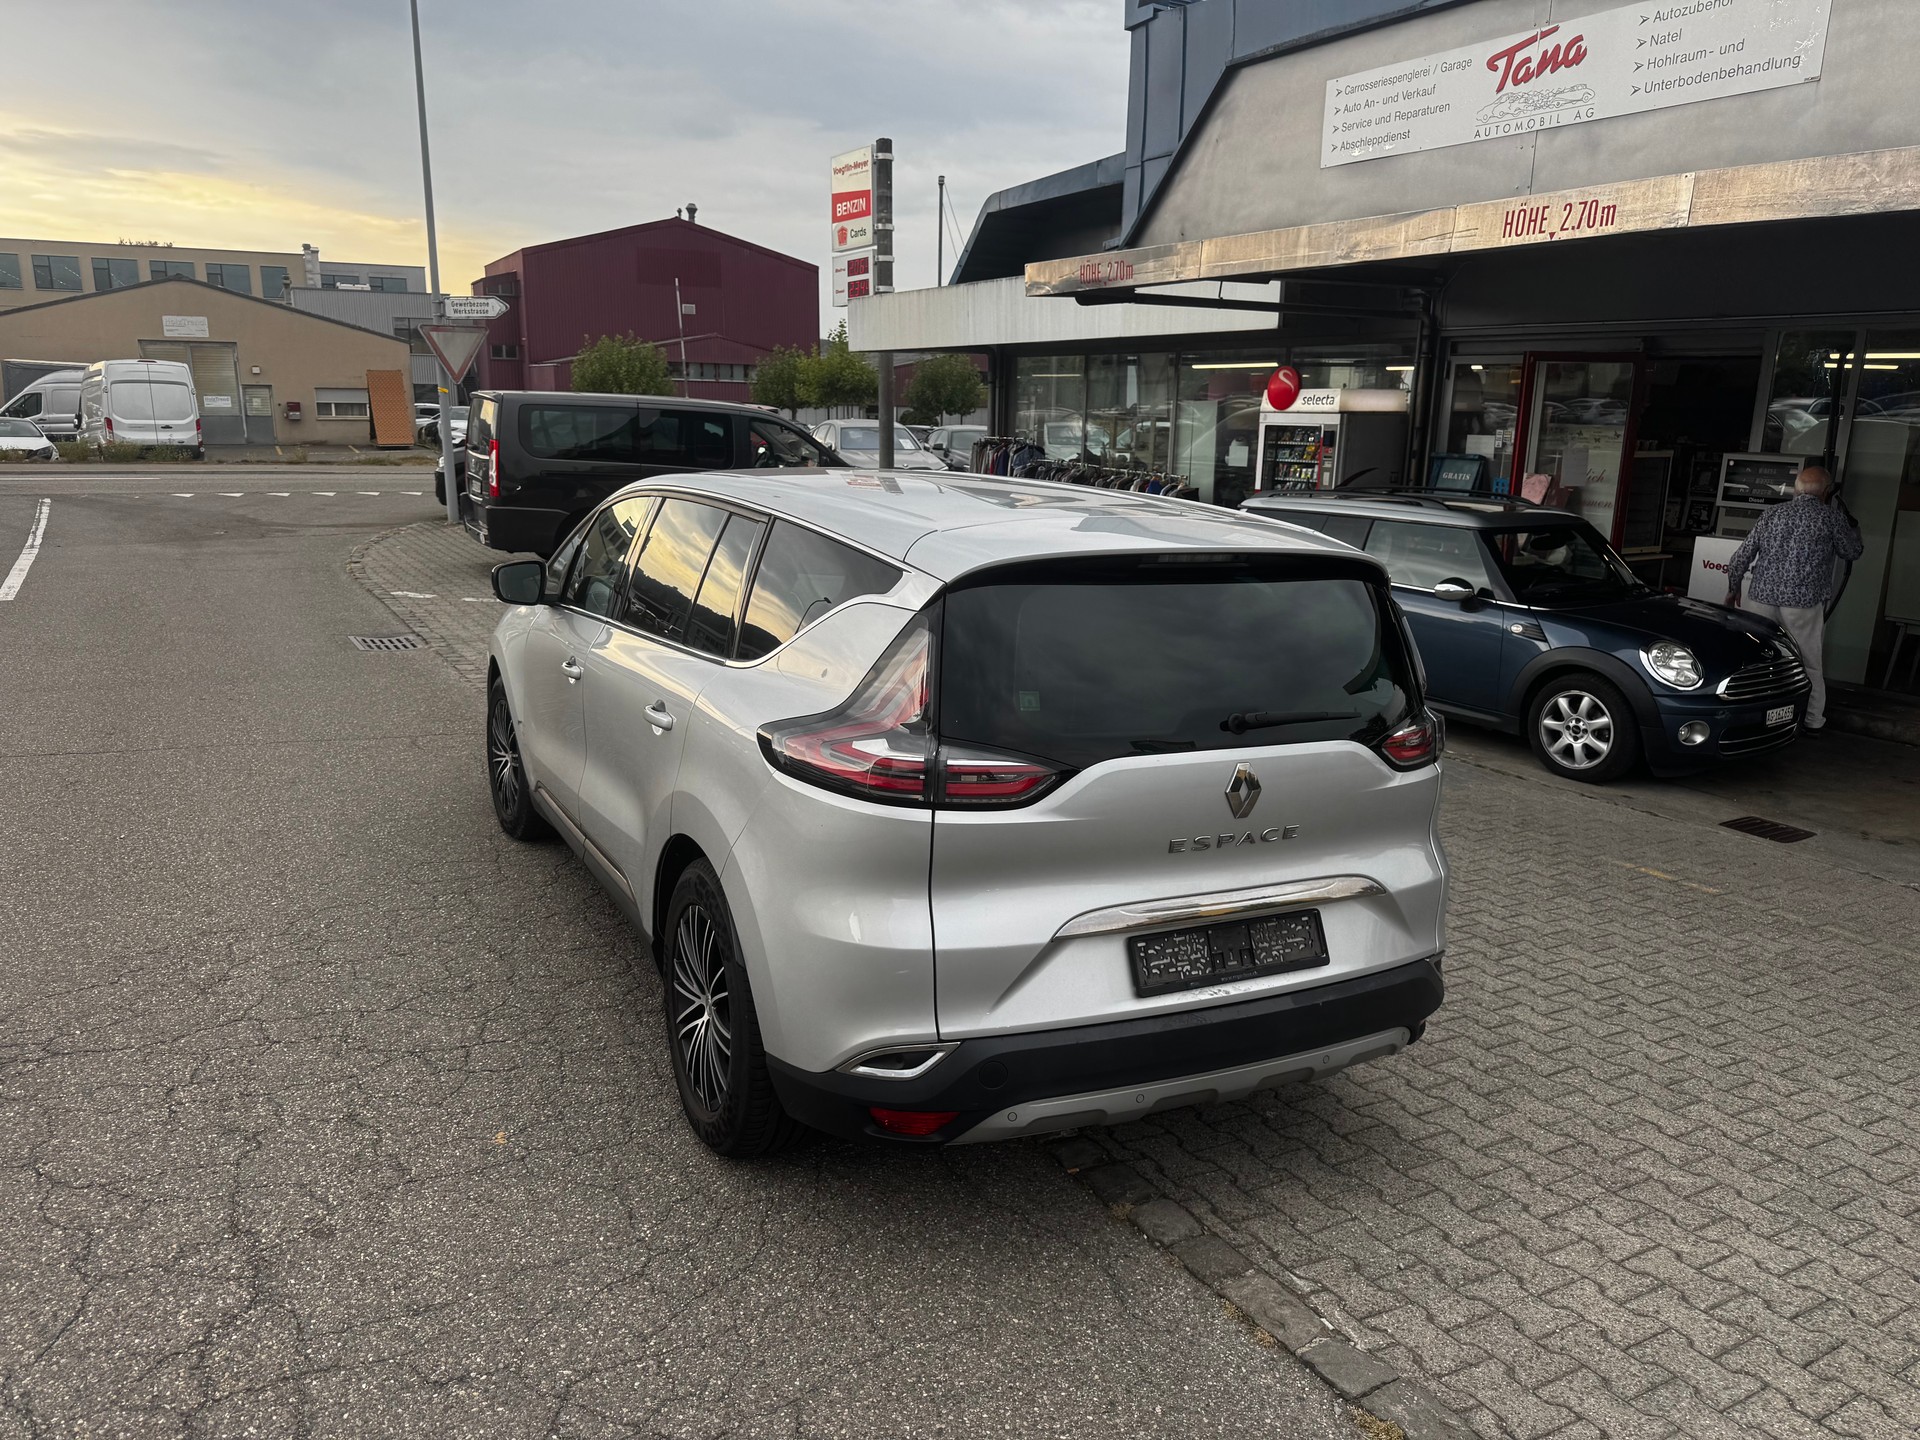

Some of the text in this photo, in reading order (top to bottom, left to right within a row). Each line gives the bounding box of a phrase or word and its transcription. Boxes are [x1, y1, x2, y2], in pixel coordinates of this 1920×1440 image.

[1649, 28, 1683, 47] Natel
[1486, 23, 1588, 94] Tana
[1646, 38, 1745, 70] Hohlraum- und
[1344, 65, 1431, 96] Carrosseriespenglerei
[1440, 58, 1473, 73] Garage
[1644, 54, 1801, 94] Unterbodenbehandlung
[1343, 83, 1437, 114] Auto An- und Verkauf
[1341, 102, 1451, 133] Service und Reparaturen
[1473, 107, 1596, 139] AUTOMOBIL AG
[1340, 129, 1411, 152] Abschleppdienst
[836, 197, 866, 216] BENZIN
[1502, 202, 1550, 239] HÖHE
[850, 227, 867, 239] Cards
[1080, 260, 1102, 284] HÖHE
[1301, 394, 1335, 406] selecta
[1442, 472, 1471, 481] GRATIS
[1168, 824, 1300, 853] ESPACE
